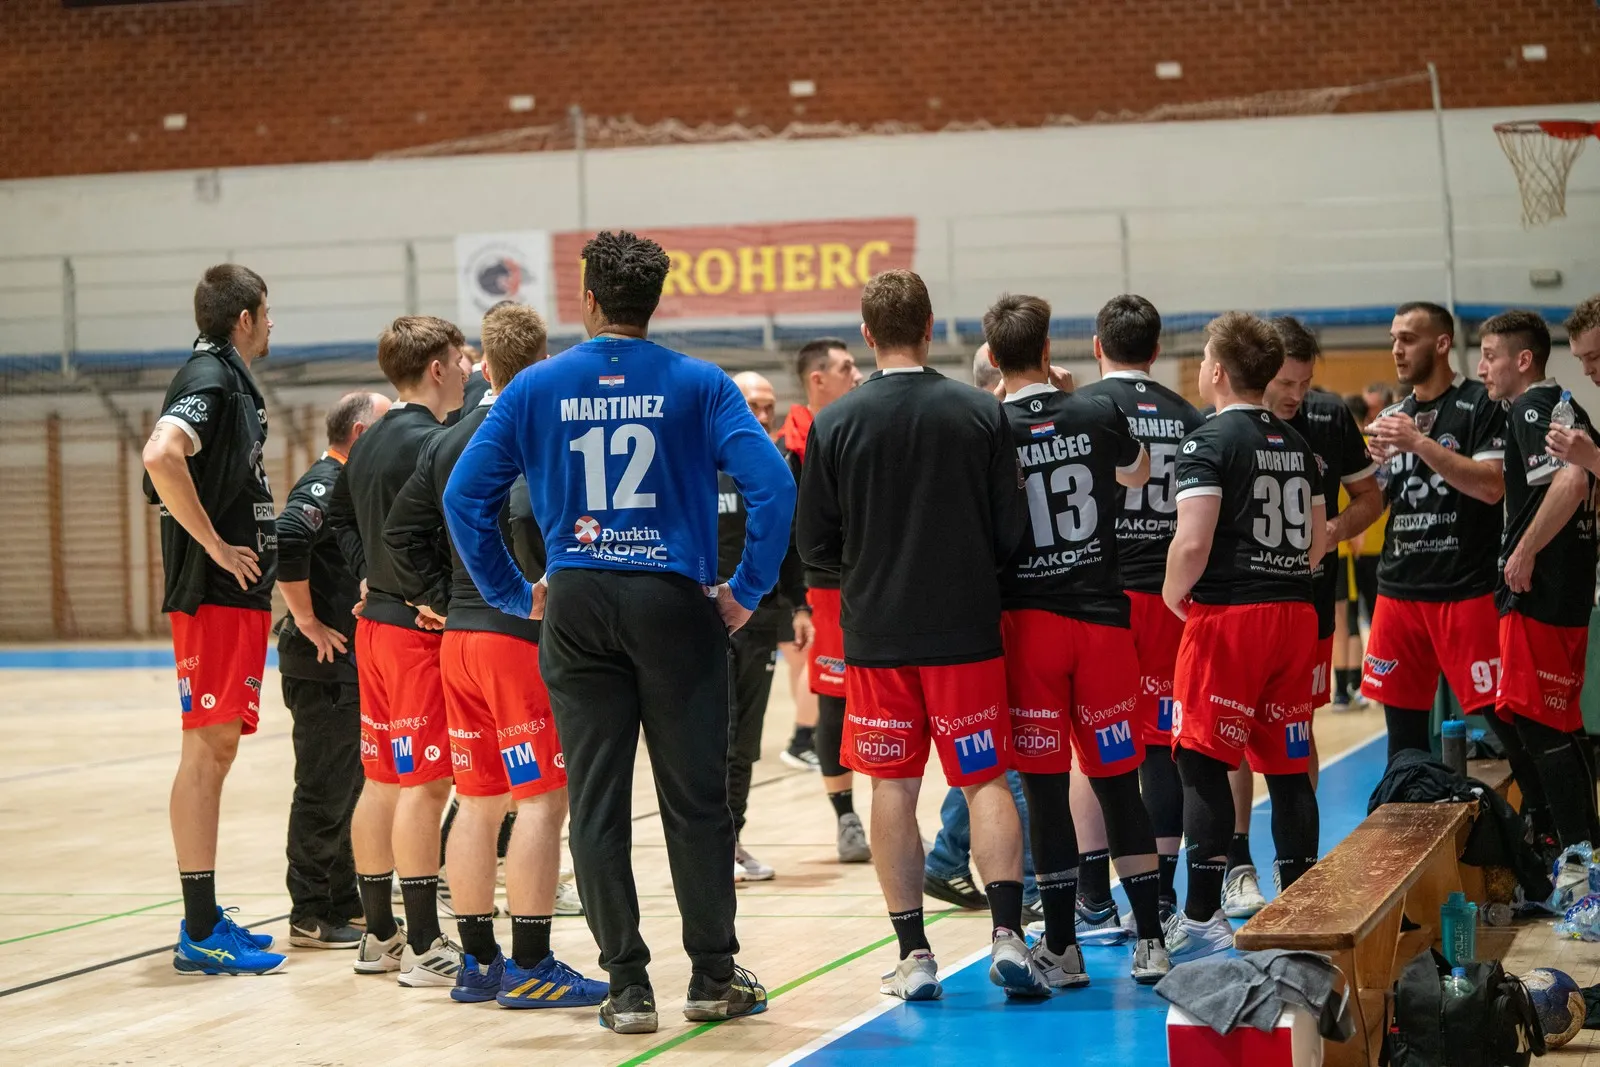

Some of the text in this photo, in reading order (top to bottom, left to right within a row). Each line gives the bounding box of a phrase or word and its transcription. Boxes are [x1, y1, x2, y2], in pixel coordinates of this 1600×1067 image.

[580, 241, 890, 296] ROHERC
[171, 402, 201, 423] plus
[560, 395, 664, 422] MARTINEZ
[1127, 417, 1184, 439] RANJEC
[1016, 434, 1092, 468] KALČEC
[1256, 449, 1304, 472] HORVAT
[570, 424, 656, 511] 12
[1025, 464, 1098, 548] 13
[1252, 475, 1312, 550] 39
[602, 527, 660, 543] Đurkin
[566, 543, 668, 560] JAKOPIĆ
[1160, 696, 1173, 714] T
[1544, 694, 1566, 710] VAJD
[848, 714, 912, 728] metaloBox
[950, 702, 1000, 731] NEORE
[448, 728, 480, 739] loBox
[498, 718, 546, 742] NEORES
[1096, 720, 1131, 747] TM
[1286, 721, 1310, 742] TM
[361, 740, 378, 756] JDA
[392, 736, 412, 758] TM
[856, 740, 900, 757] VAJDA
[954, 729, 994, 756] TM
[502, 742, 536, 768] TM
[181, 872, 211, 880] empa
